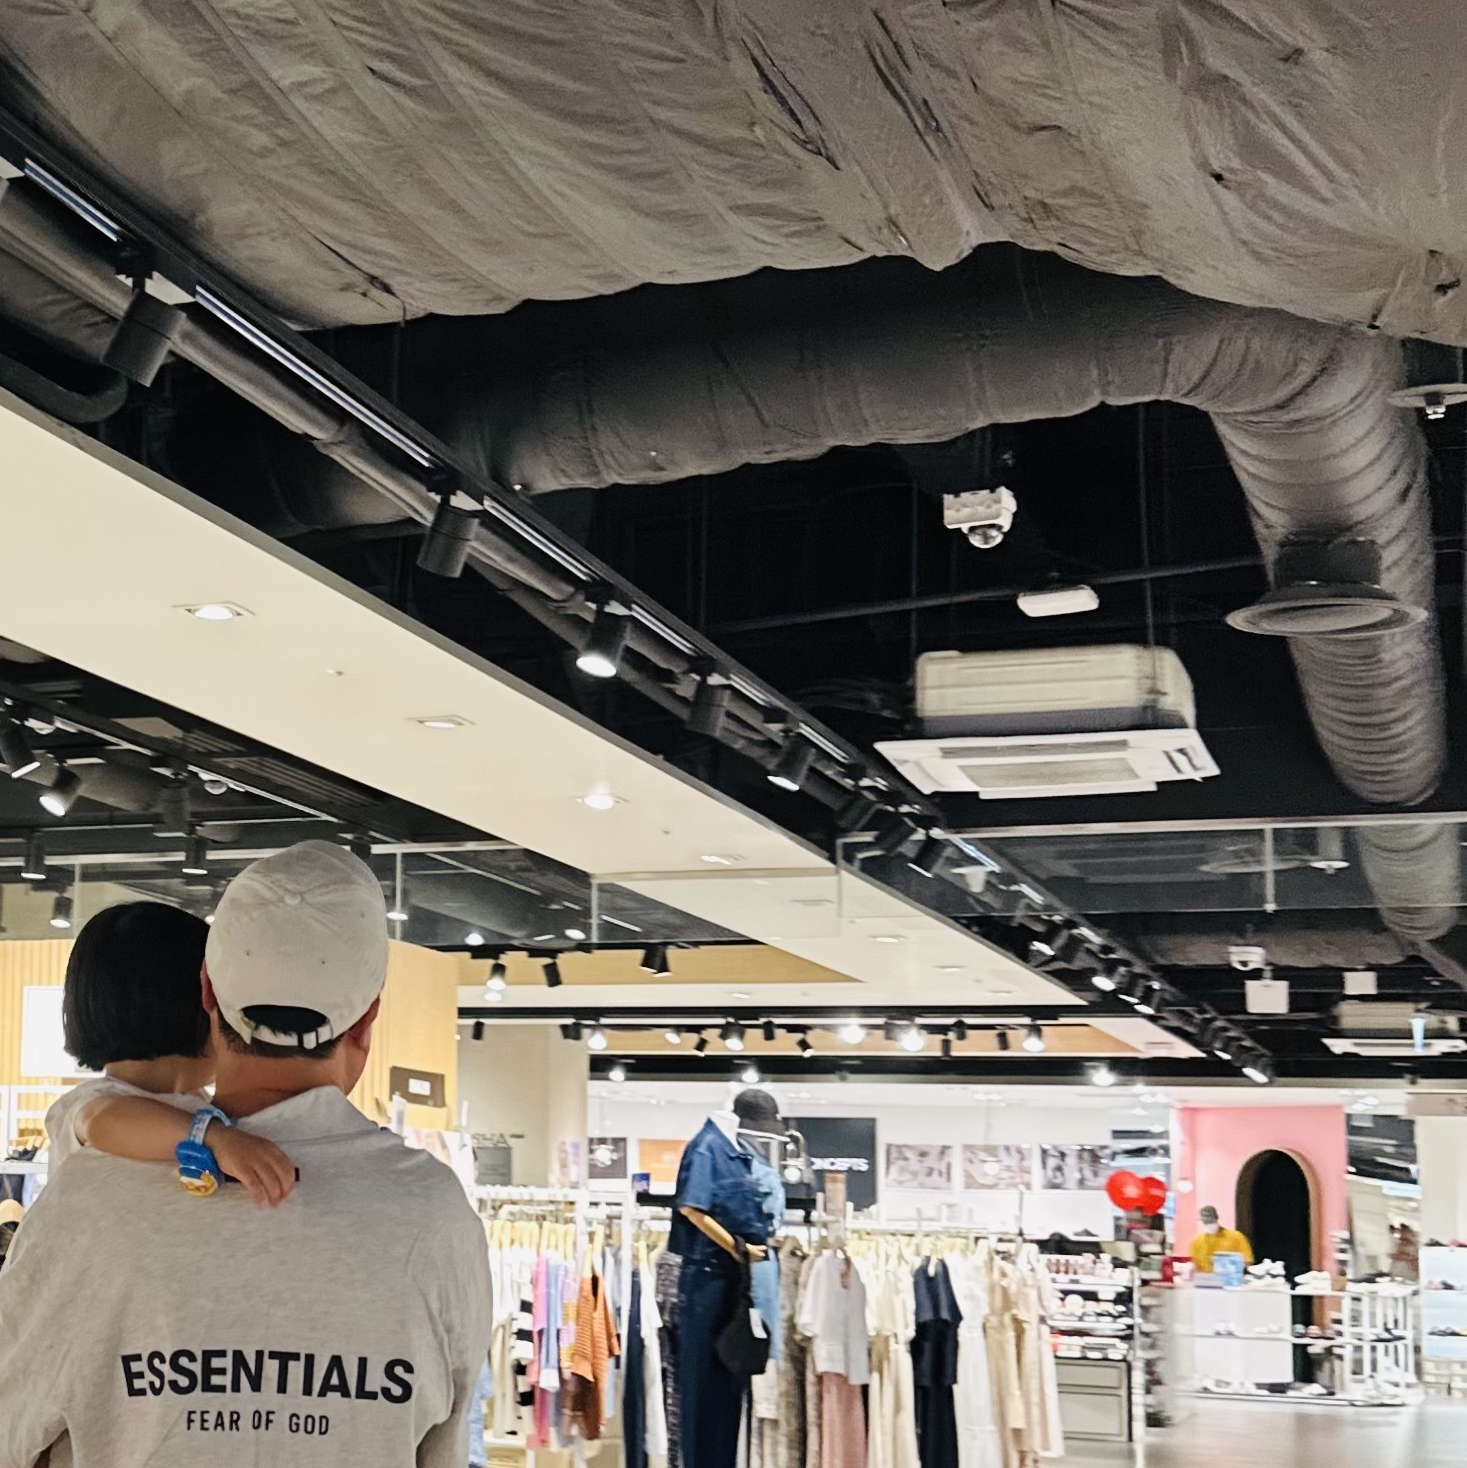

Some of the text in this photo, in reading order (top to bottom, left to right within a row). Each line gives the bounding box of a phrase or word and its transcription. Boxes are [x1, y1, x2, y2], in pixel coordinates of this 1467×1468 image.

[120, 1349, 415, 1405] ESSENTIALS
[186, 1409, 330, 1436] FEAR OF GOD
